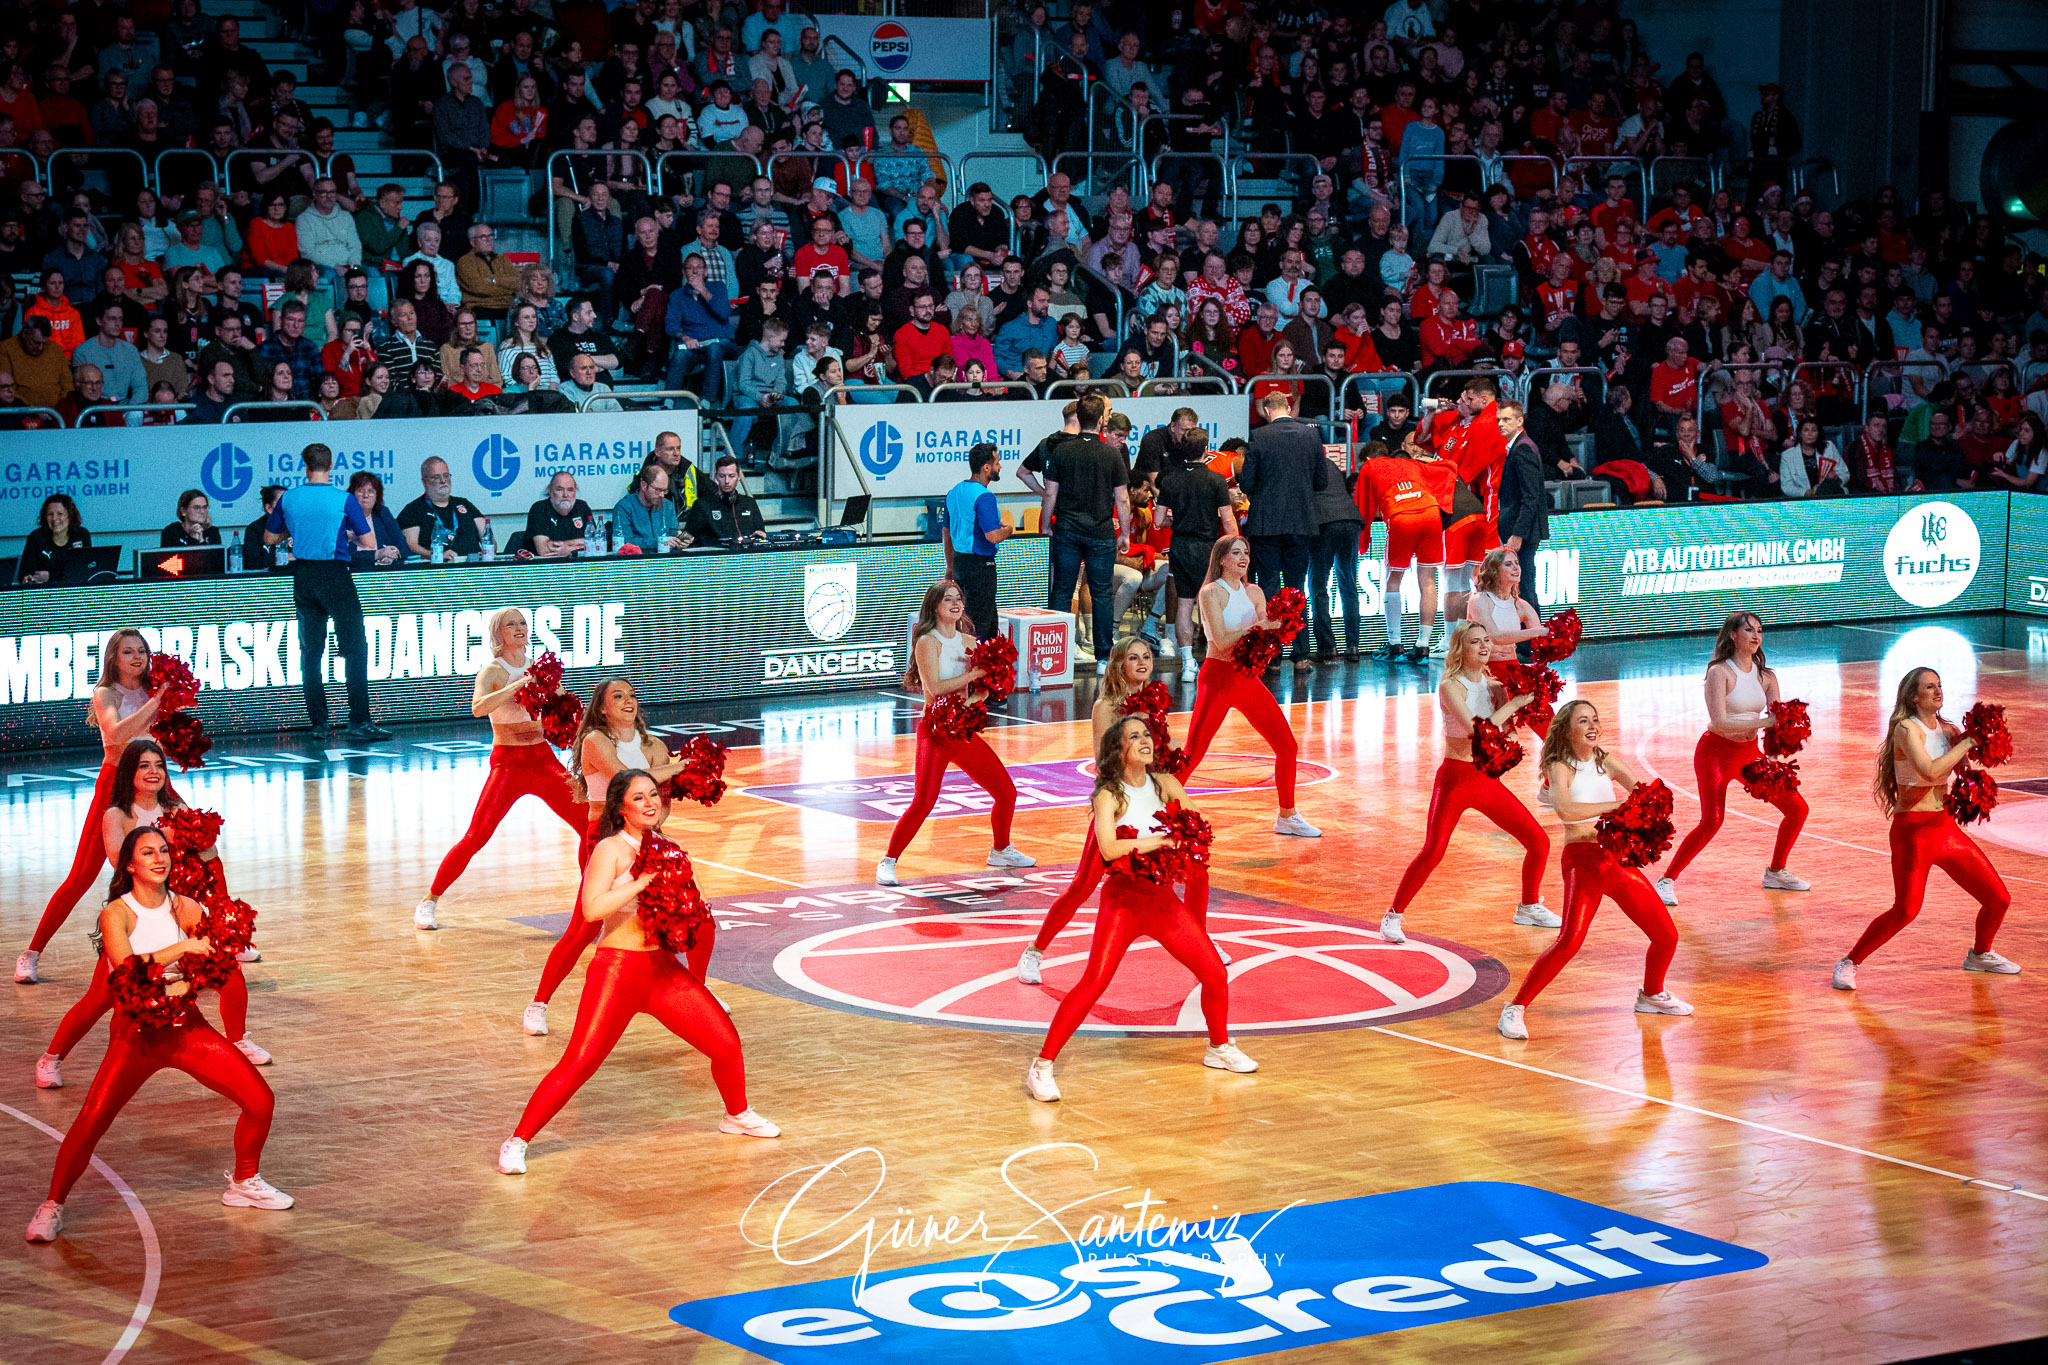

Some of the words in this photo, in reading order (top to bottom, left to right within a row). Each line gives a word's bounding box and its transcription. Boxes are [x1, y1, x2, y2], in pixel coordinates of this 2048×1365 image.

[873, 41, 909, 52] PEPSI
[916, 429, 1021, 448] IGARASHI
[535, 440, 651, 462] IGARASHI
[915, 451, 969, 463] MOTORE
[268, 450, 394, 472] IGASHI
[535, 465, 607, 478] MOTOREN
[610, 463, 641, 475] GMB
[268, 474, 345, 489] MOTEN
[0, 484, 77, 499] MOTOREN
[82, 482, 130, 497] GMBH
[1622, 548, 1660, 574] ATB
[1661, 540, 1791, 572] AUTOTECHNIK
[1792, 537, 1846, 563] GMBH
[1895, 553, 1971, 576] fuchs
[1033, 630, 1063, 646] RHÖN
[1034, 645, 1063, 656] PRUDEL
[765, 649, 895, 679] DANCERS
